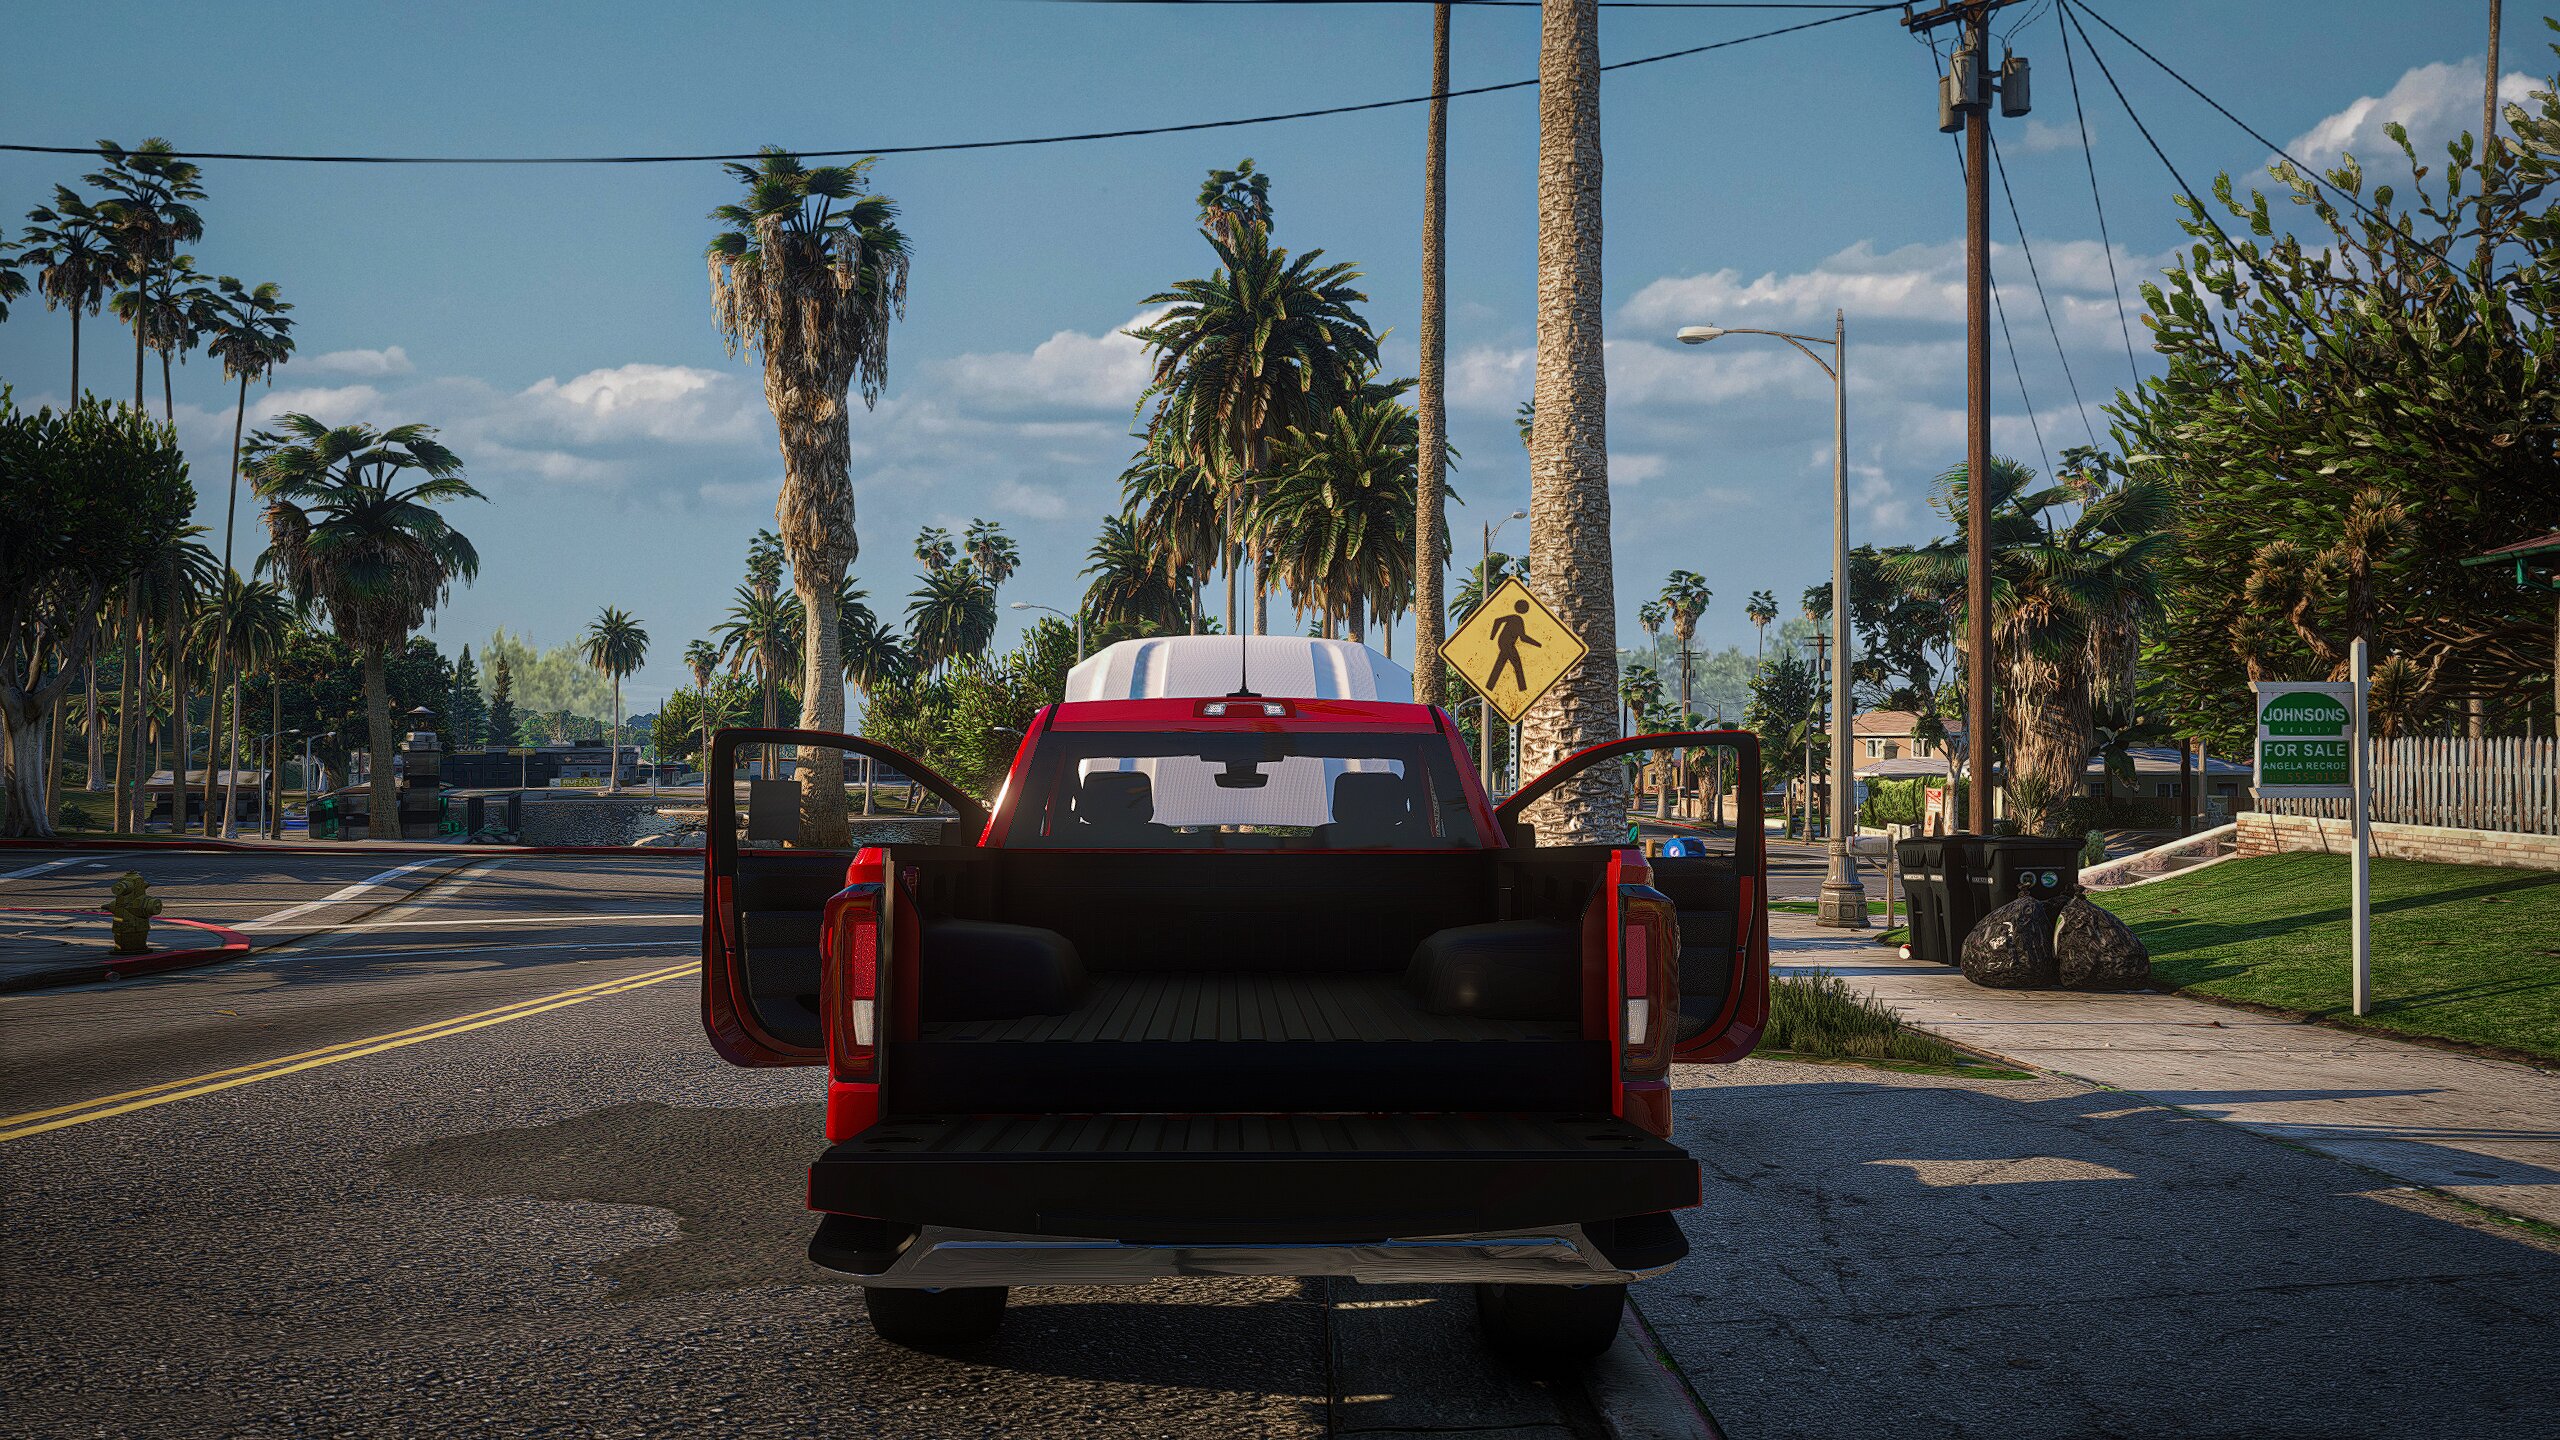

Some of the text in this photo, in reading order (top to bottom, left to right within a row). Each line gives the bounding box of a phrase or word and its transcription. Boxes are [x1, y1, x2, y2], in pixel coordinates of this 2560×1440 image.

[2263, 708, 2345, 721] JOHNSONS
[2265, 744, 2346, 757] FOR SALE
[2262, 761, 2347, 770] ANGELA RECROE
